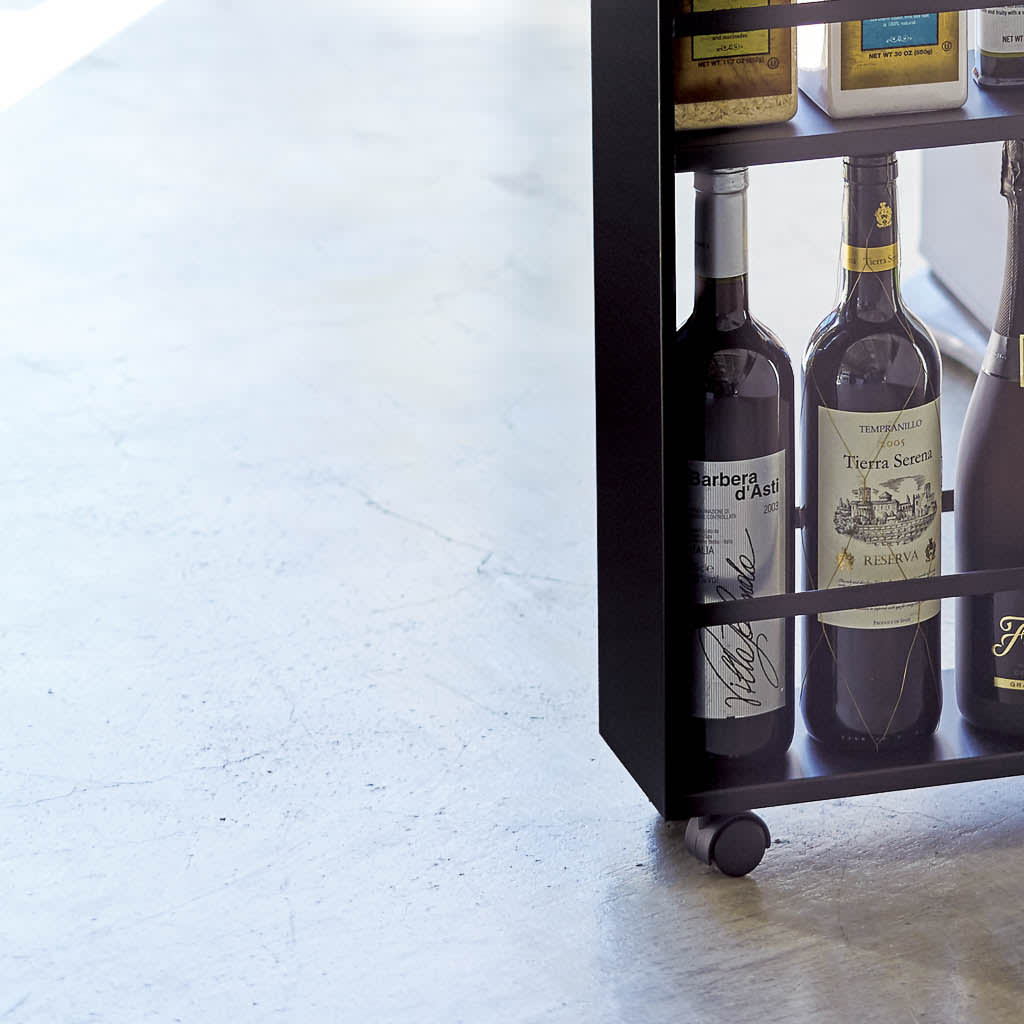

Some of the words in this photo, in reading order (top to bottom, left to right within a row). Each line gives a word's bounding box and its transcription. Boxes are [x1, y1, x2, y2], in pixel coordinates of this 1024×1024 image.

[859, 419, 922, 434] TEMPRANILLO
[843, 454, 889, 470] Tierra
[894, 449, 933, 468] Serena
[735, 478, 779, 500] d'Asti
[864, 551, 919, 566] RESERVA
